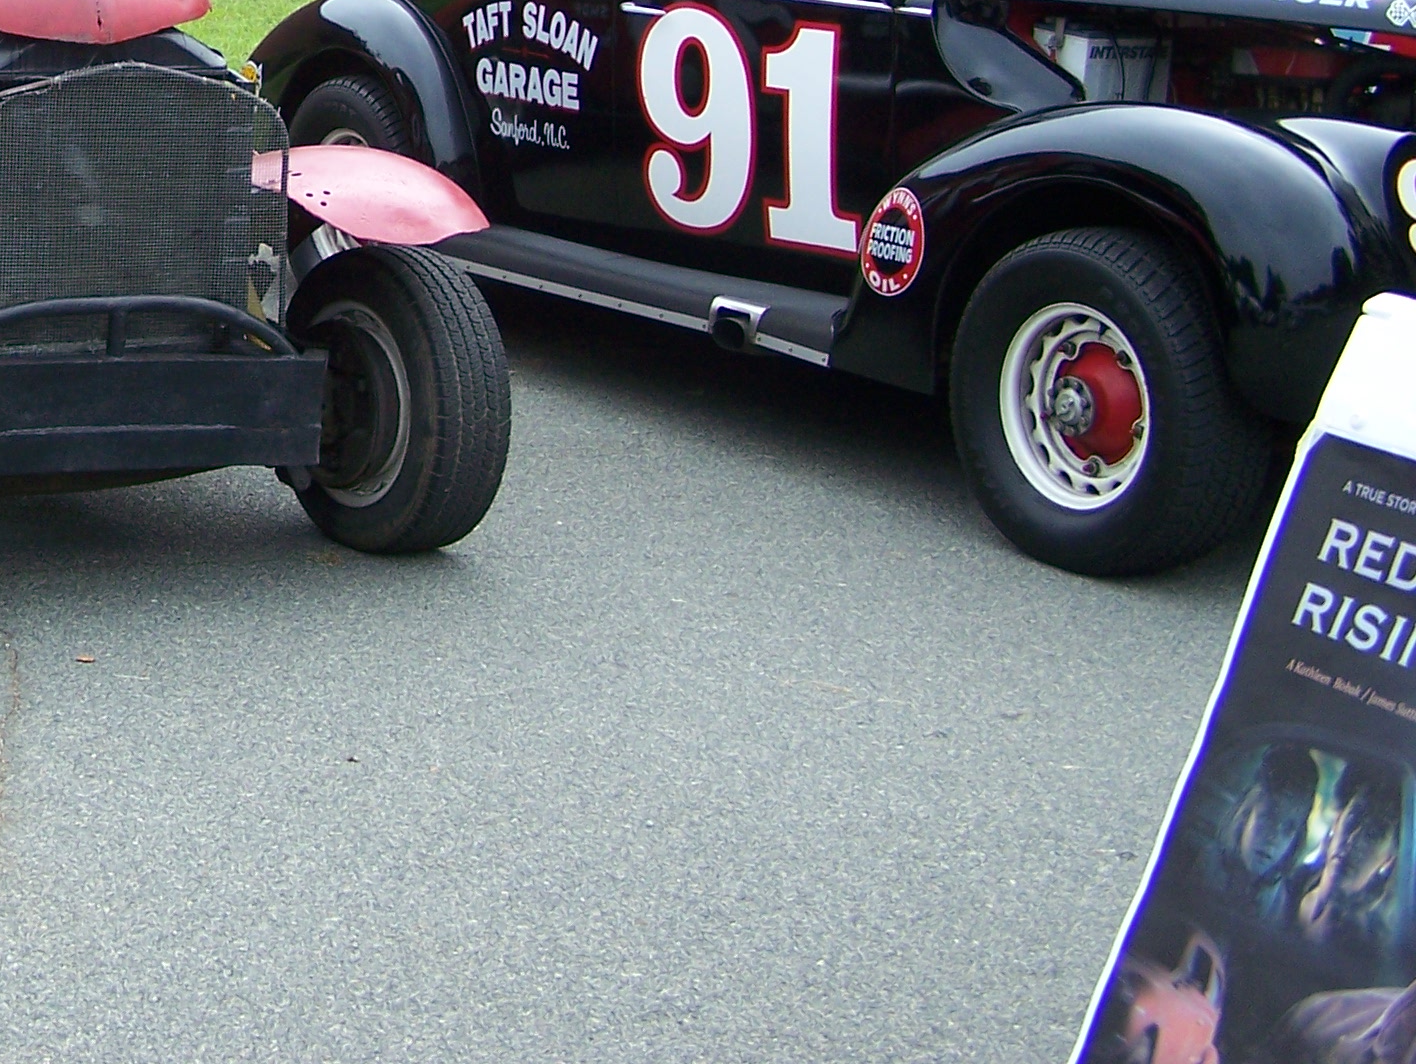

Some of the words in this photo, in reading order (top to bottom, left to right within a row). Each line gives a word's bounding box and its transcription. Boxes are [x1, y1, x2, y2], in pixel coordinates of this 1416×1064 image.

[462, 1, 512, 49] TAFT
[522, 1, 599, 71] SLOAN
[476, 57, 580, 111] GARAGE
[640, 4, 861, 256] 91
[867, 238, 913, 264] PROOFING
[870, 222, 915, 247] FRICTION
[869, 270, 901, 292] OIL
[1342, 480, 1353, 495] A
[1355, 482, 1386, 506] TRUE
[1316, 517, 1416, 592] RED
[1290, 581, 1416, 668] RISI
